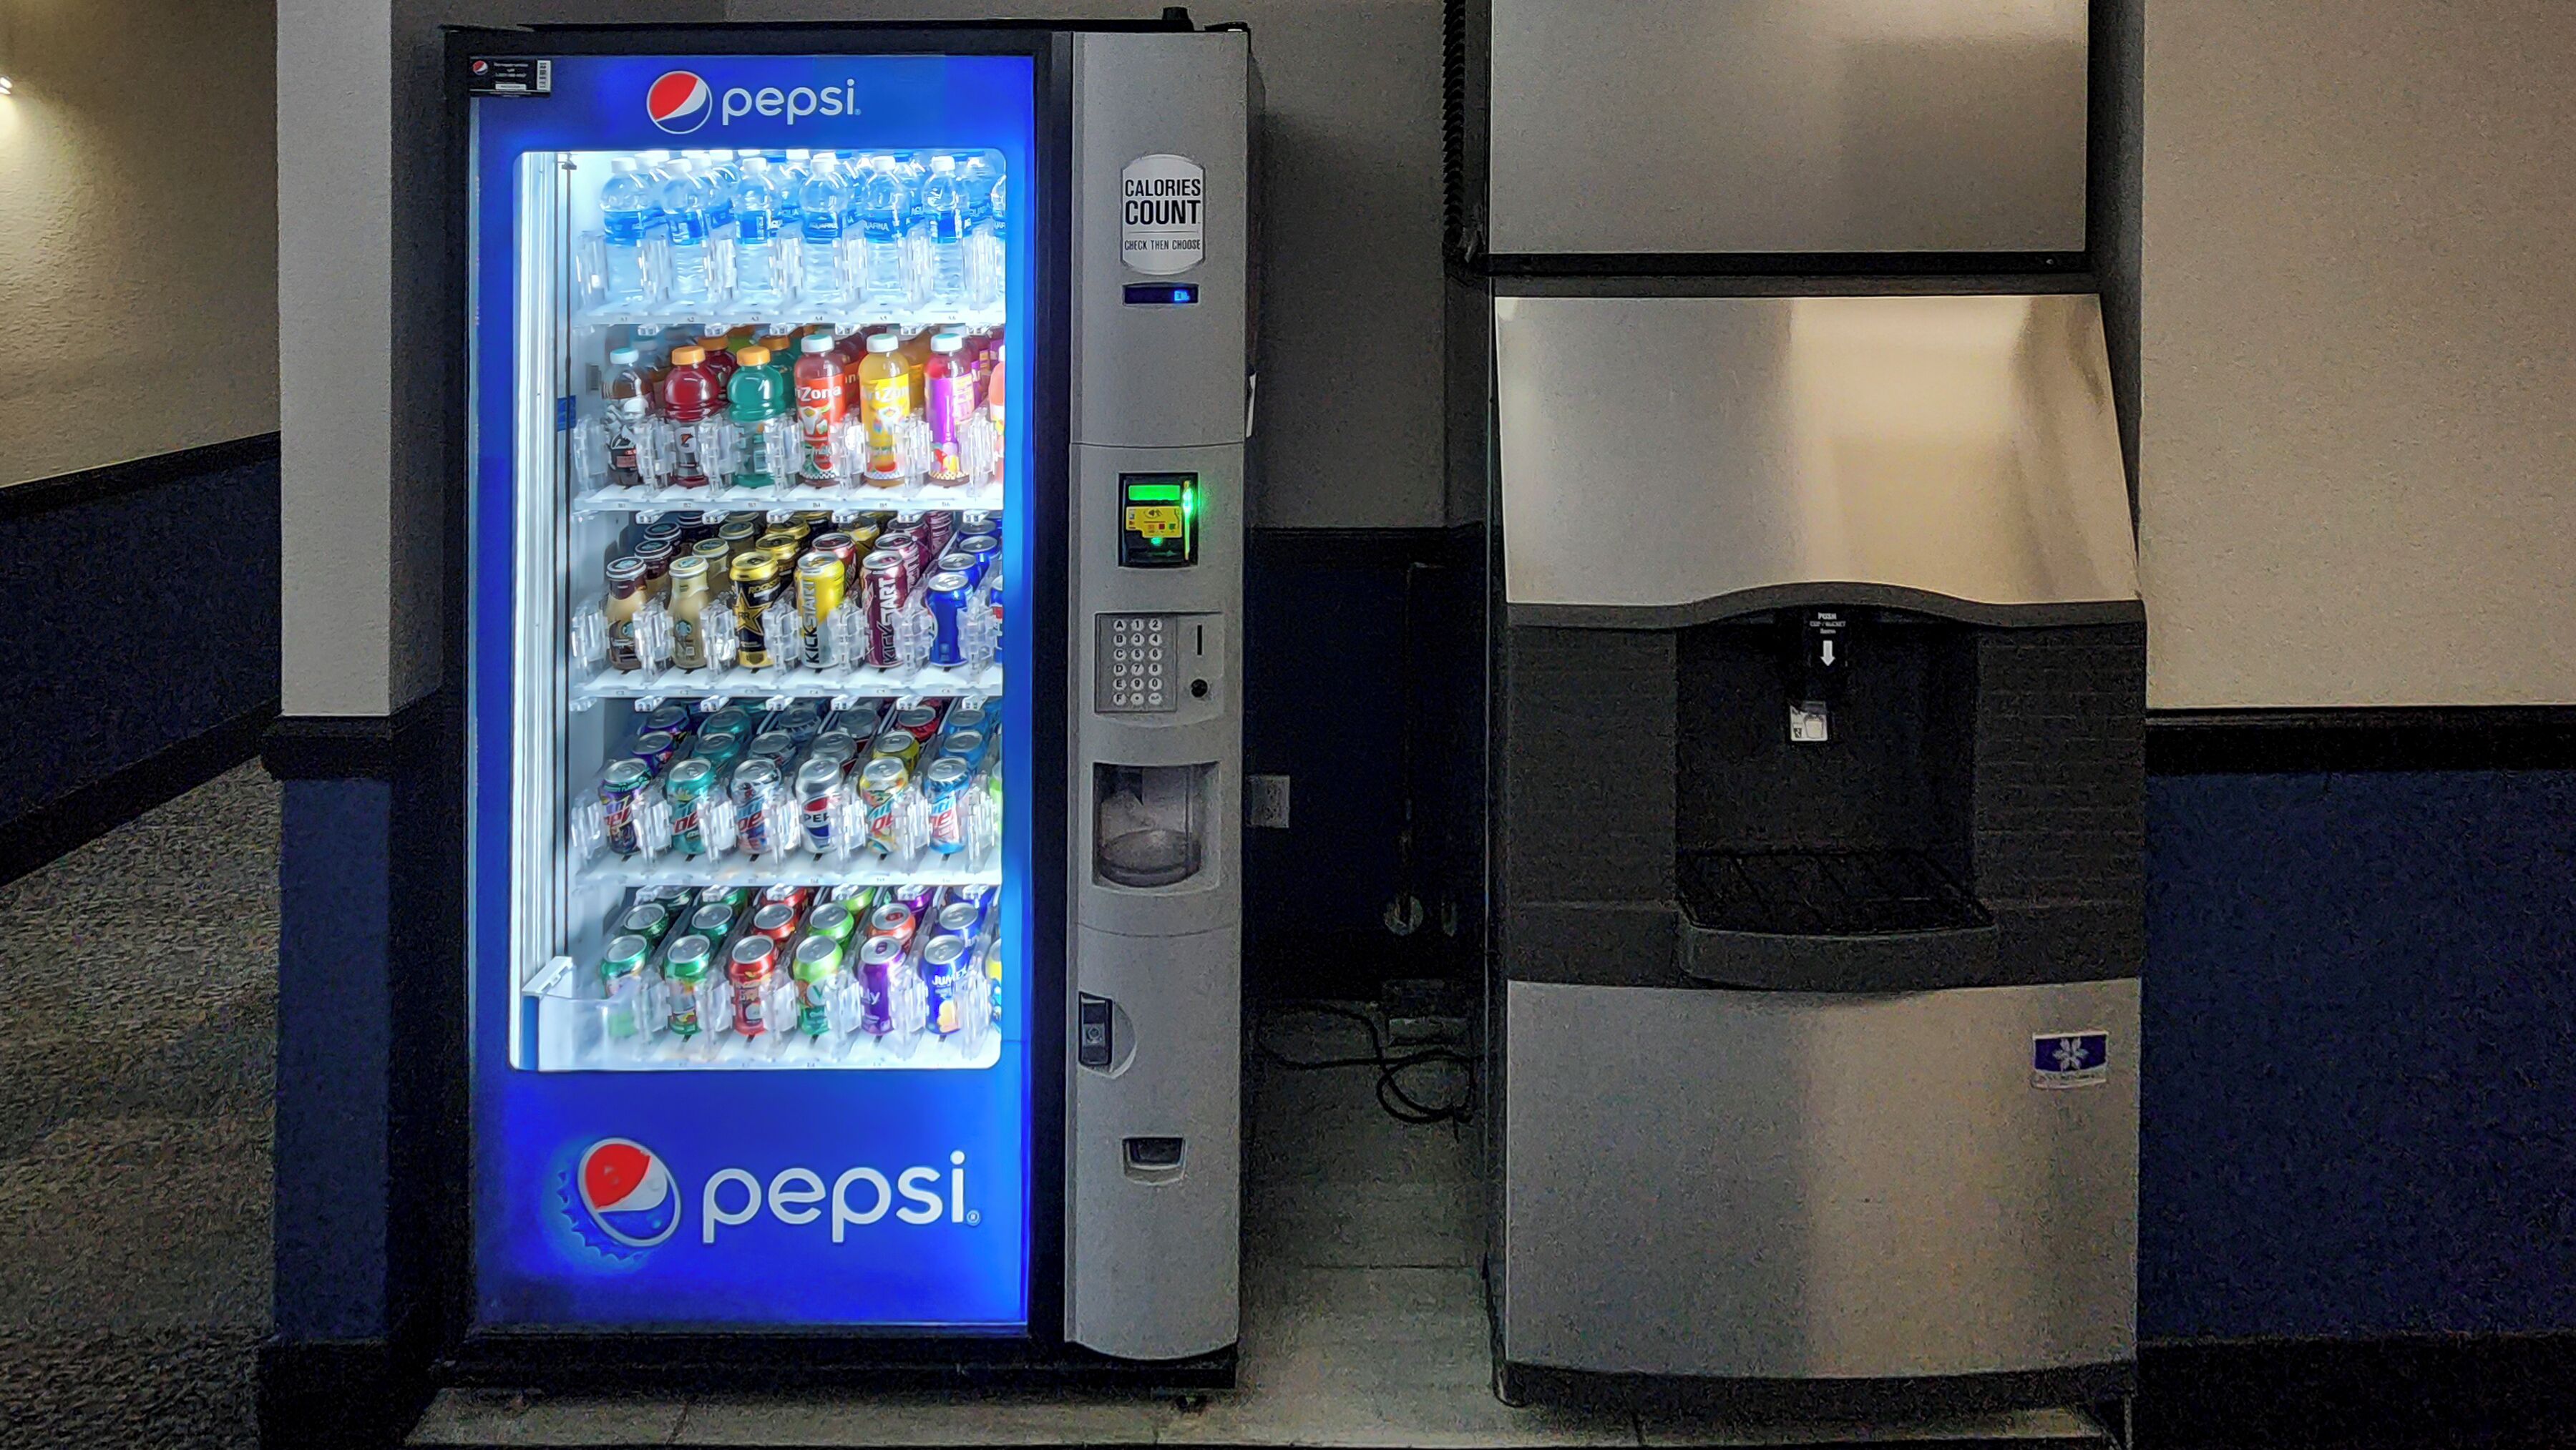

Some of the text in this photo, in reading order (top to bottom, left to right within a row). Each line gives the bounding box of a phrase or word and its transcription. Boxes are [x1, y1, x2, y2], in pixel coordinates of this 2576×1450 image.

[722, 79, 854, 126] pepsi
[1125, 179, 1201, 197] CALORIES
[1125, 200, 1201, 225] COUNT
[1124, 239, 1201, 250] CHECK THEN CHOOSE
[802, 581, 820, 664] KICKSTART
[877, 577, 896, 664] KICKSTART
[703, 1150, 965, 1244] pepsi
